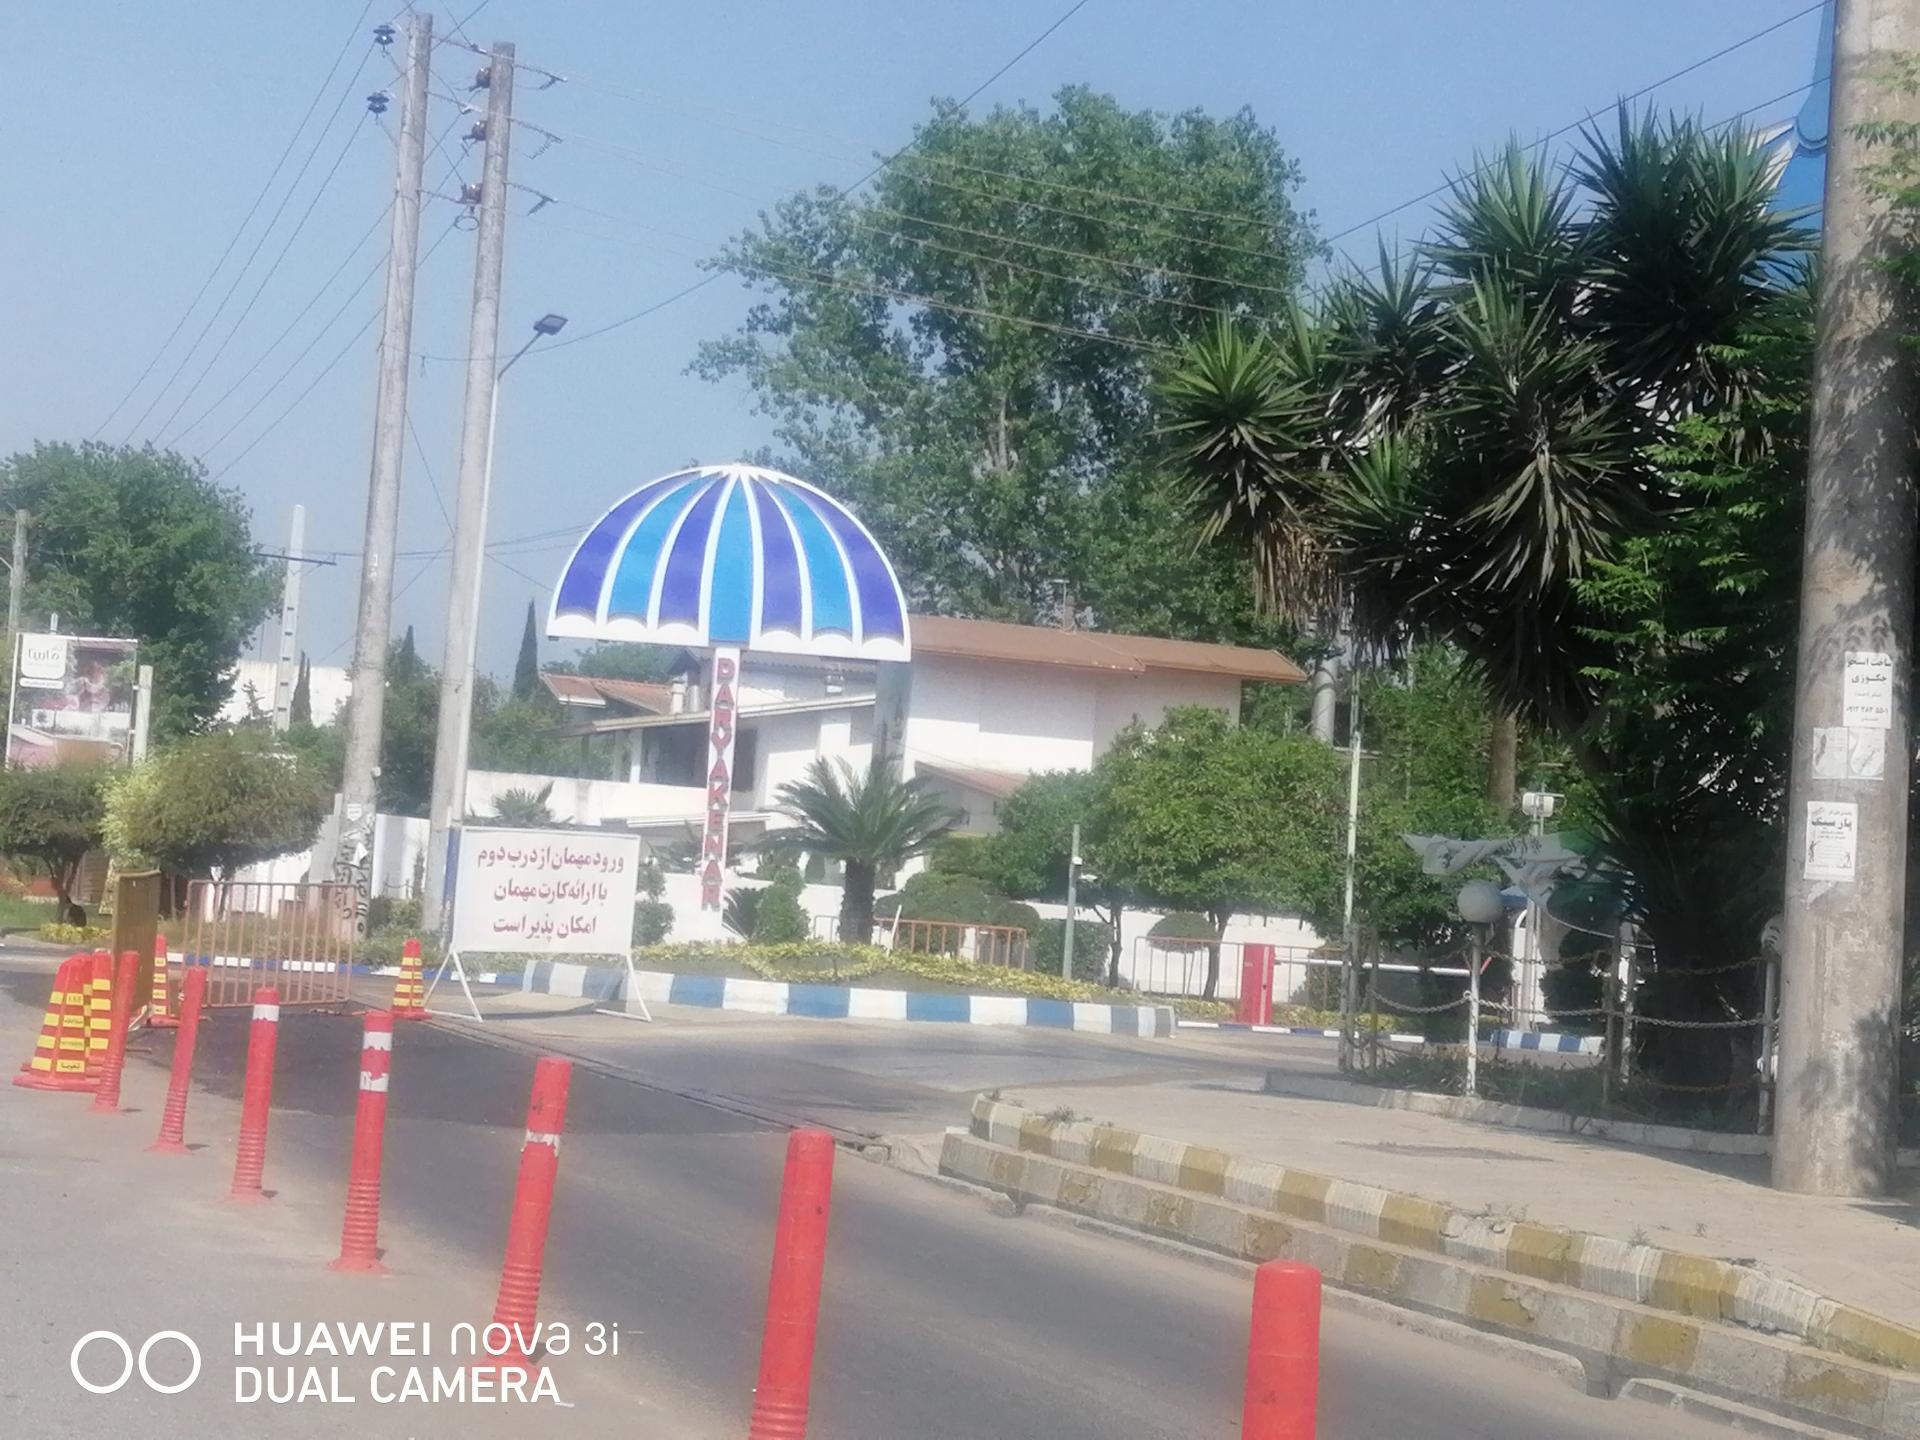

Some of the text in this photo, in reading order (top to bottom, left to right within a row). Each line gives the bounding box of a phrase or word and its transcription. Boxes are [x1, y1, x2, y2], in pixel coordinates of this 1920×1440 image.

[701, 657, 736, 912] DARYAKENAR
[477, 846, 624, 873] ورود مهمان از درب دوم
[494, 878, 608, 906] با ارائه کارت مهمان
[493, 912, 597, 943] امکان پذیر است
